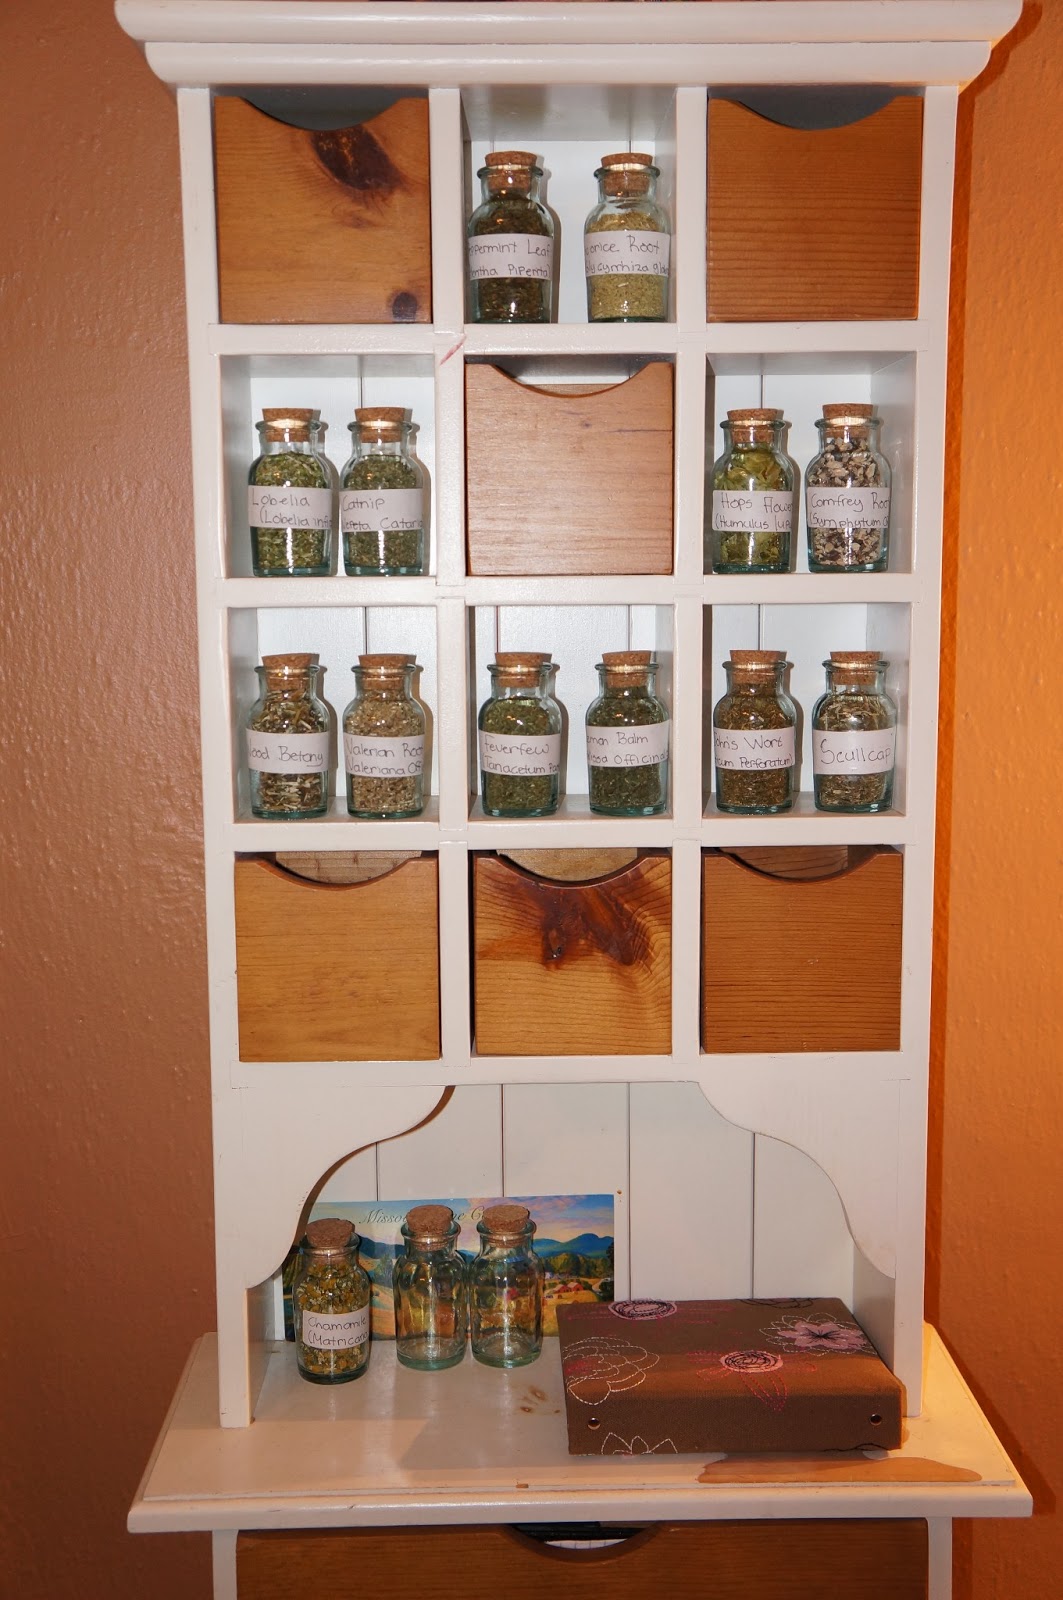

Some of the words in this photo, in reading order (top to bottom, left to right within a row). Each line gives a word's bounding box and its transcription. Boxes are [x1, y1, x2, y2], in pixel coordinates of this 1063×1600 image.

[527, 239, 550, 256] Leaf
[626, 234, 660, 254] Root
[252, 488, 310, 506] Lobelia
[343, 495, 385, 511] Catnip
[721, 492, 753, 511] Hops
[811, 493, 863, 512] Comfrey
[260, 506, 310, 525] (Lobelia
[716, 513, 769, 529] (Humulus
[346, 738, 394, 757] Valerian
[484, 734, 549, 755] Feverfew
[616, 732, 648, 744] Balm
[744, 735, 783, 749] Wort
[278, 746, 323, 767] Betony
[821, 739, 891, 764] Scullcap
